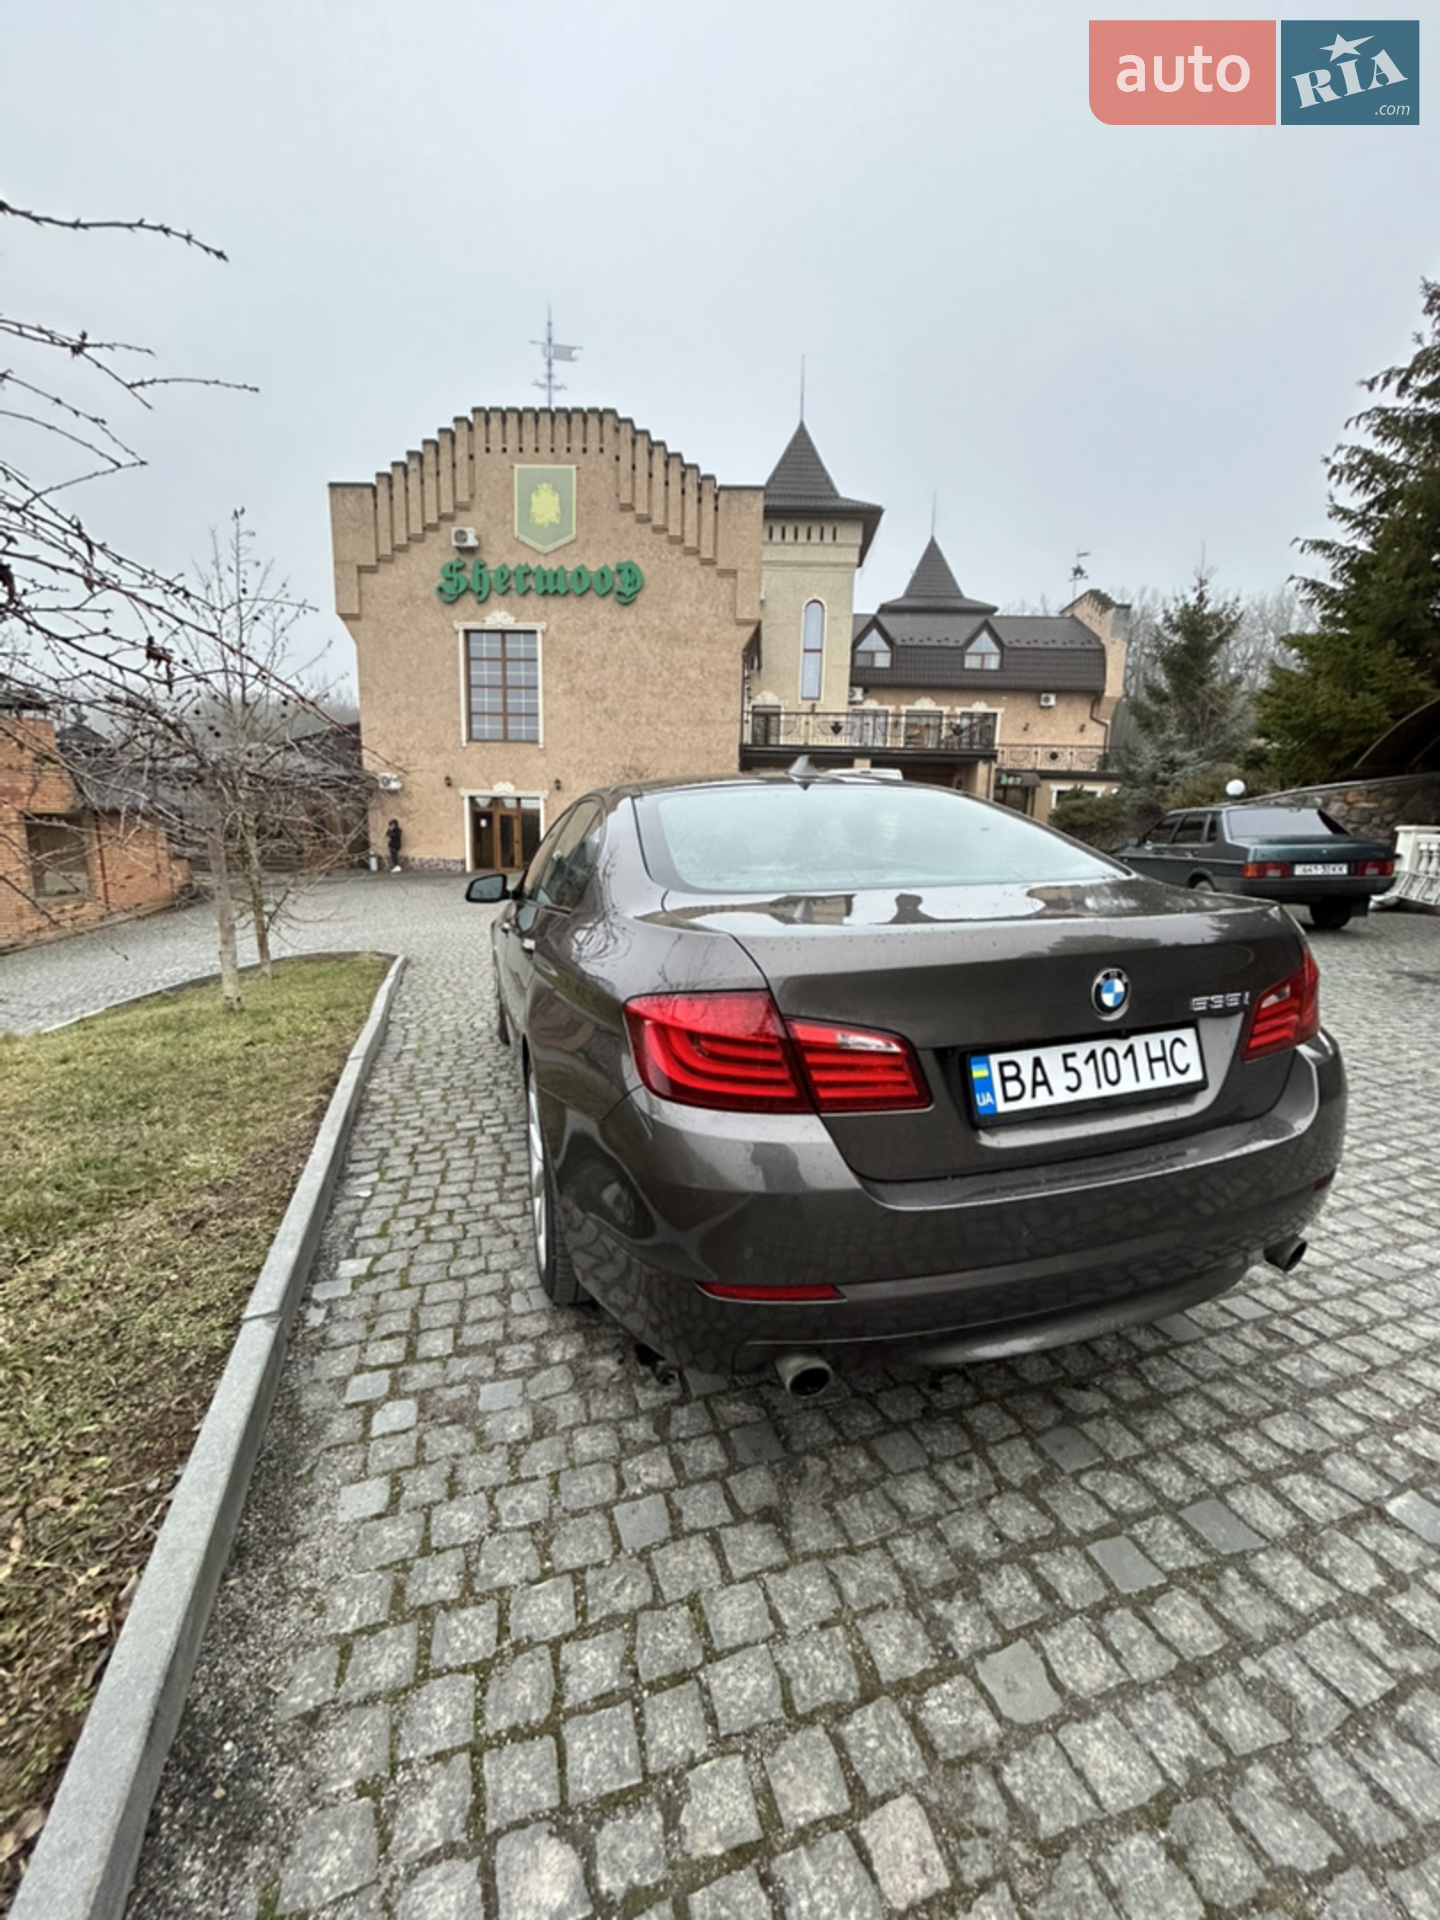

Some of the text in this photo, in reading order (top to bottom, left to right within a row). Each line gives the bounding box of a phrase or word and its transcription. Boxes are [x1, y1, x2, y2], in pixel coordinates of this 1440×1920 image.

[998, 1036, 1191, 1104] BA 5101 HC
[976, 1092, 994, 1107] UA
